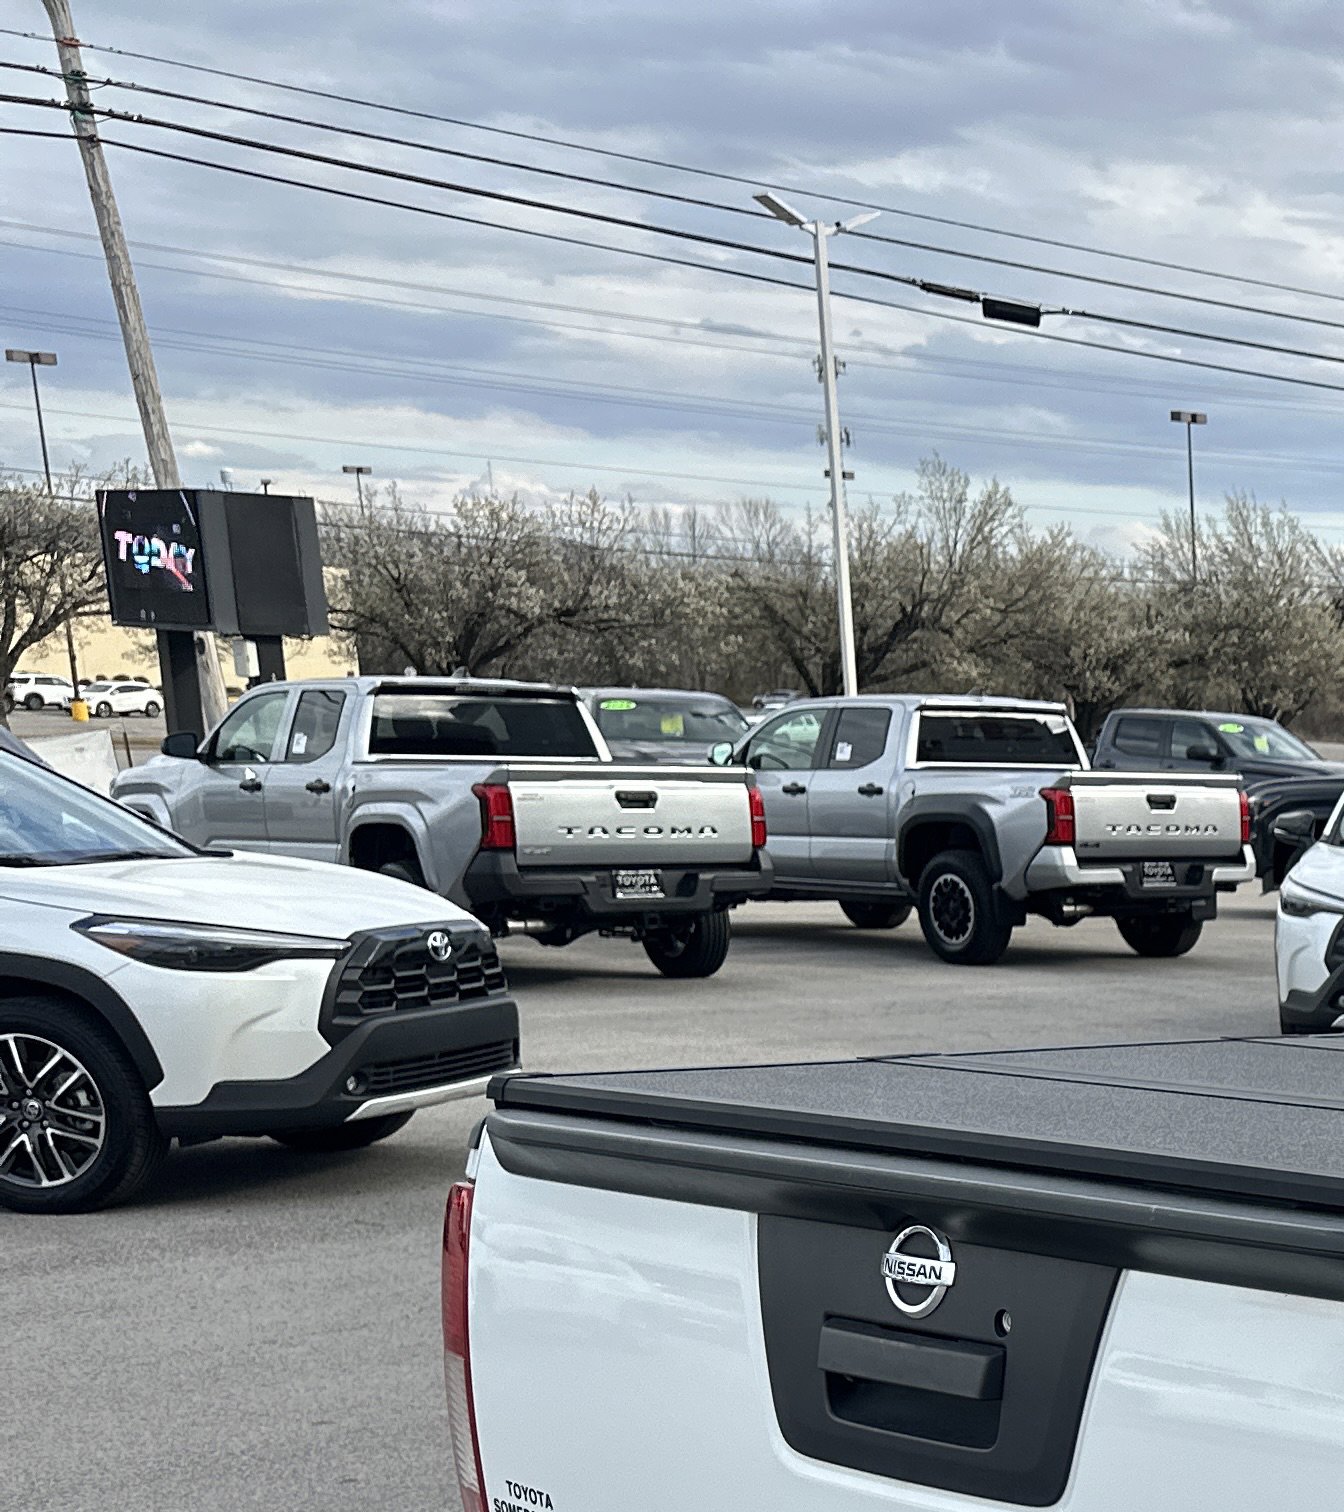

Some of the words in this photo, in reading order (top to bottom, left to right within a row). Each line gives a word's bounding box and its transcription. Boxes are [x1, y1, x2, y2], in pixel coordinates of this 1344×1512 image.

[557, 825, 719, 839] TACOMA
[1105, 823, 1219, 836] TACOMA
[616, 874, 658, 885] TOYOTA
[884, 1257, 943, 1281] NISSAN
[505, 1479, 554, 1511] TOYOTA
